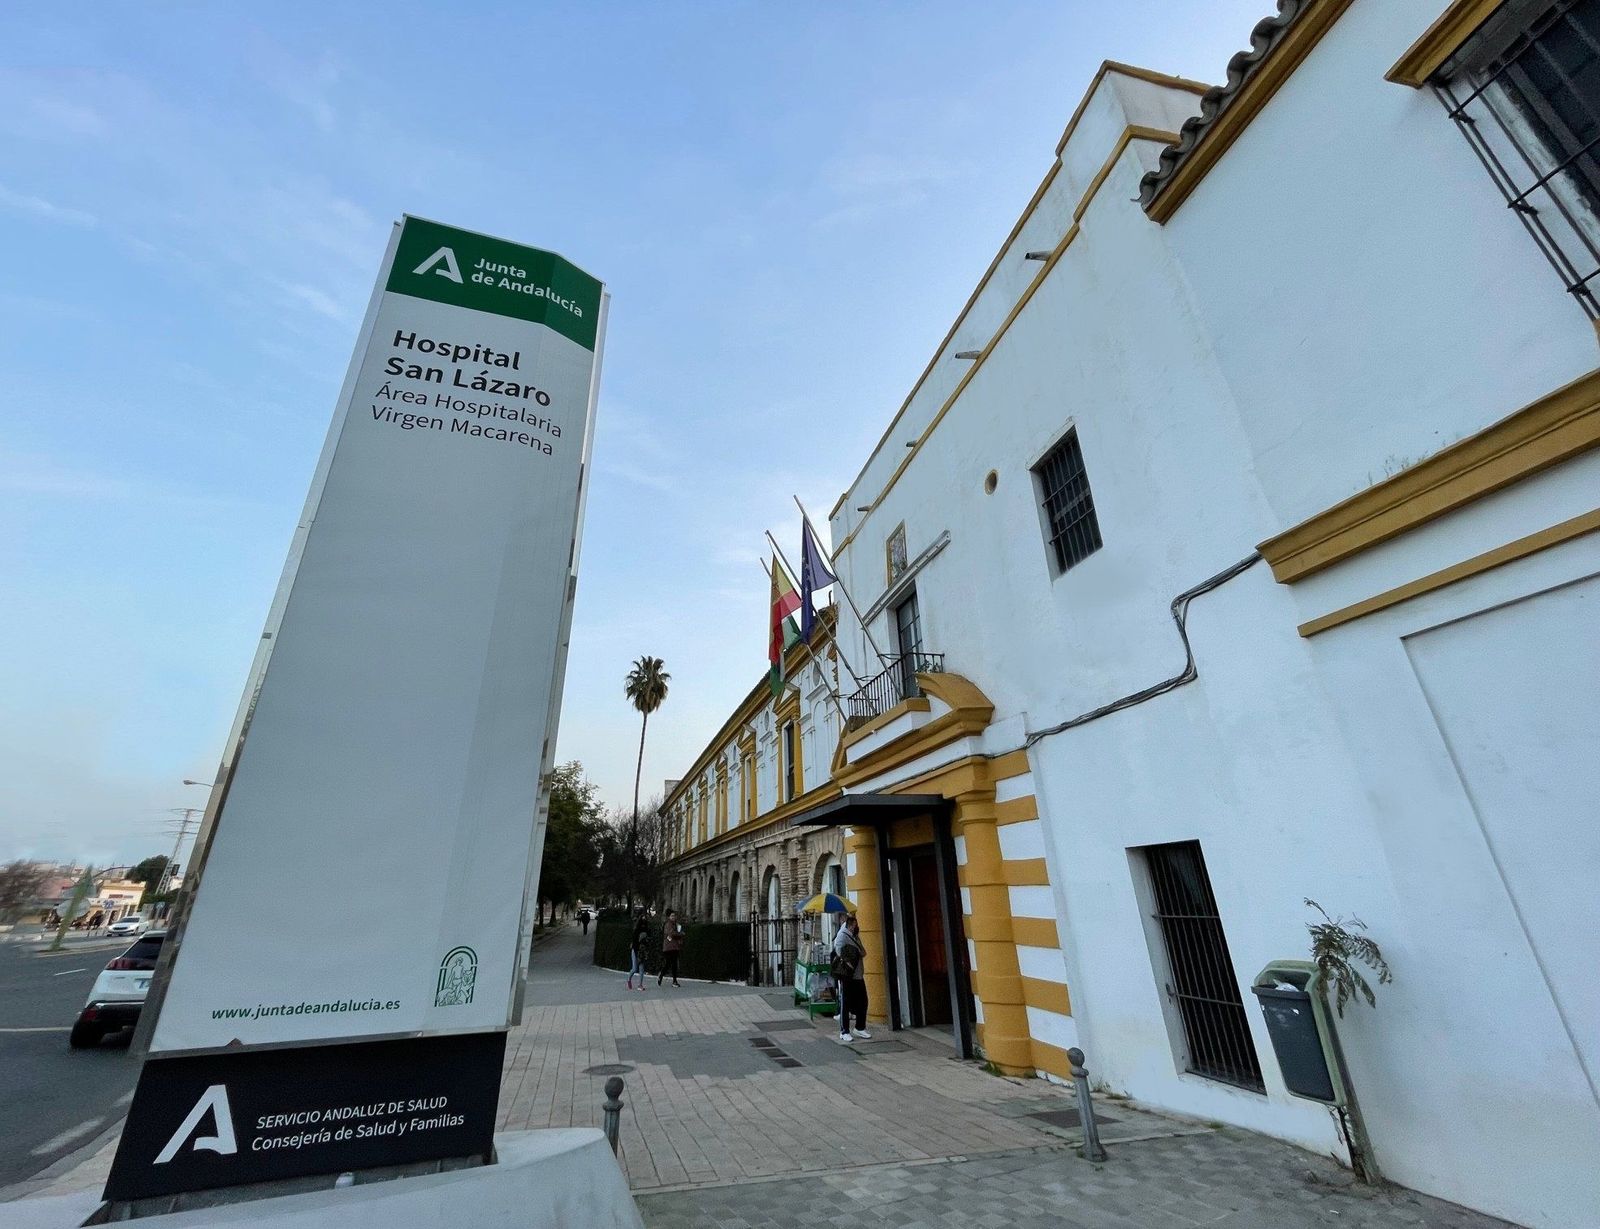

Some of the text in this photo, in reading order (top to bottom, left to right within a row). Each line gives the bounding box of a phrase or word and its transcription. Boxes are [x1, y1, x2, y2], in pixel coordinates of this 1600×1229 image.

[474, 258, 527, 279] Junta
[471, 272, 583, 318] de Andalucía
[393, 330, 520, 370] Hospital
[384, 357, 551, 407] San Lázaro
[375, 381, 562, 438] Área Hospitalaria
[372, 405, 553, 456] Virgen Macarena
[212, 998, 401, 1020] www.juntadeandalucia.es
[252, 1113, 465, 1151] Consejería de Salud y Familias
[256, 1097, 448, 1129] SERVICIO ANDALUZ DE SALUD
